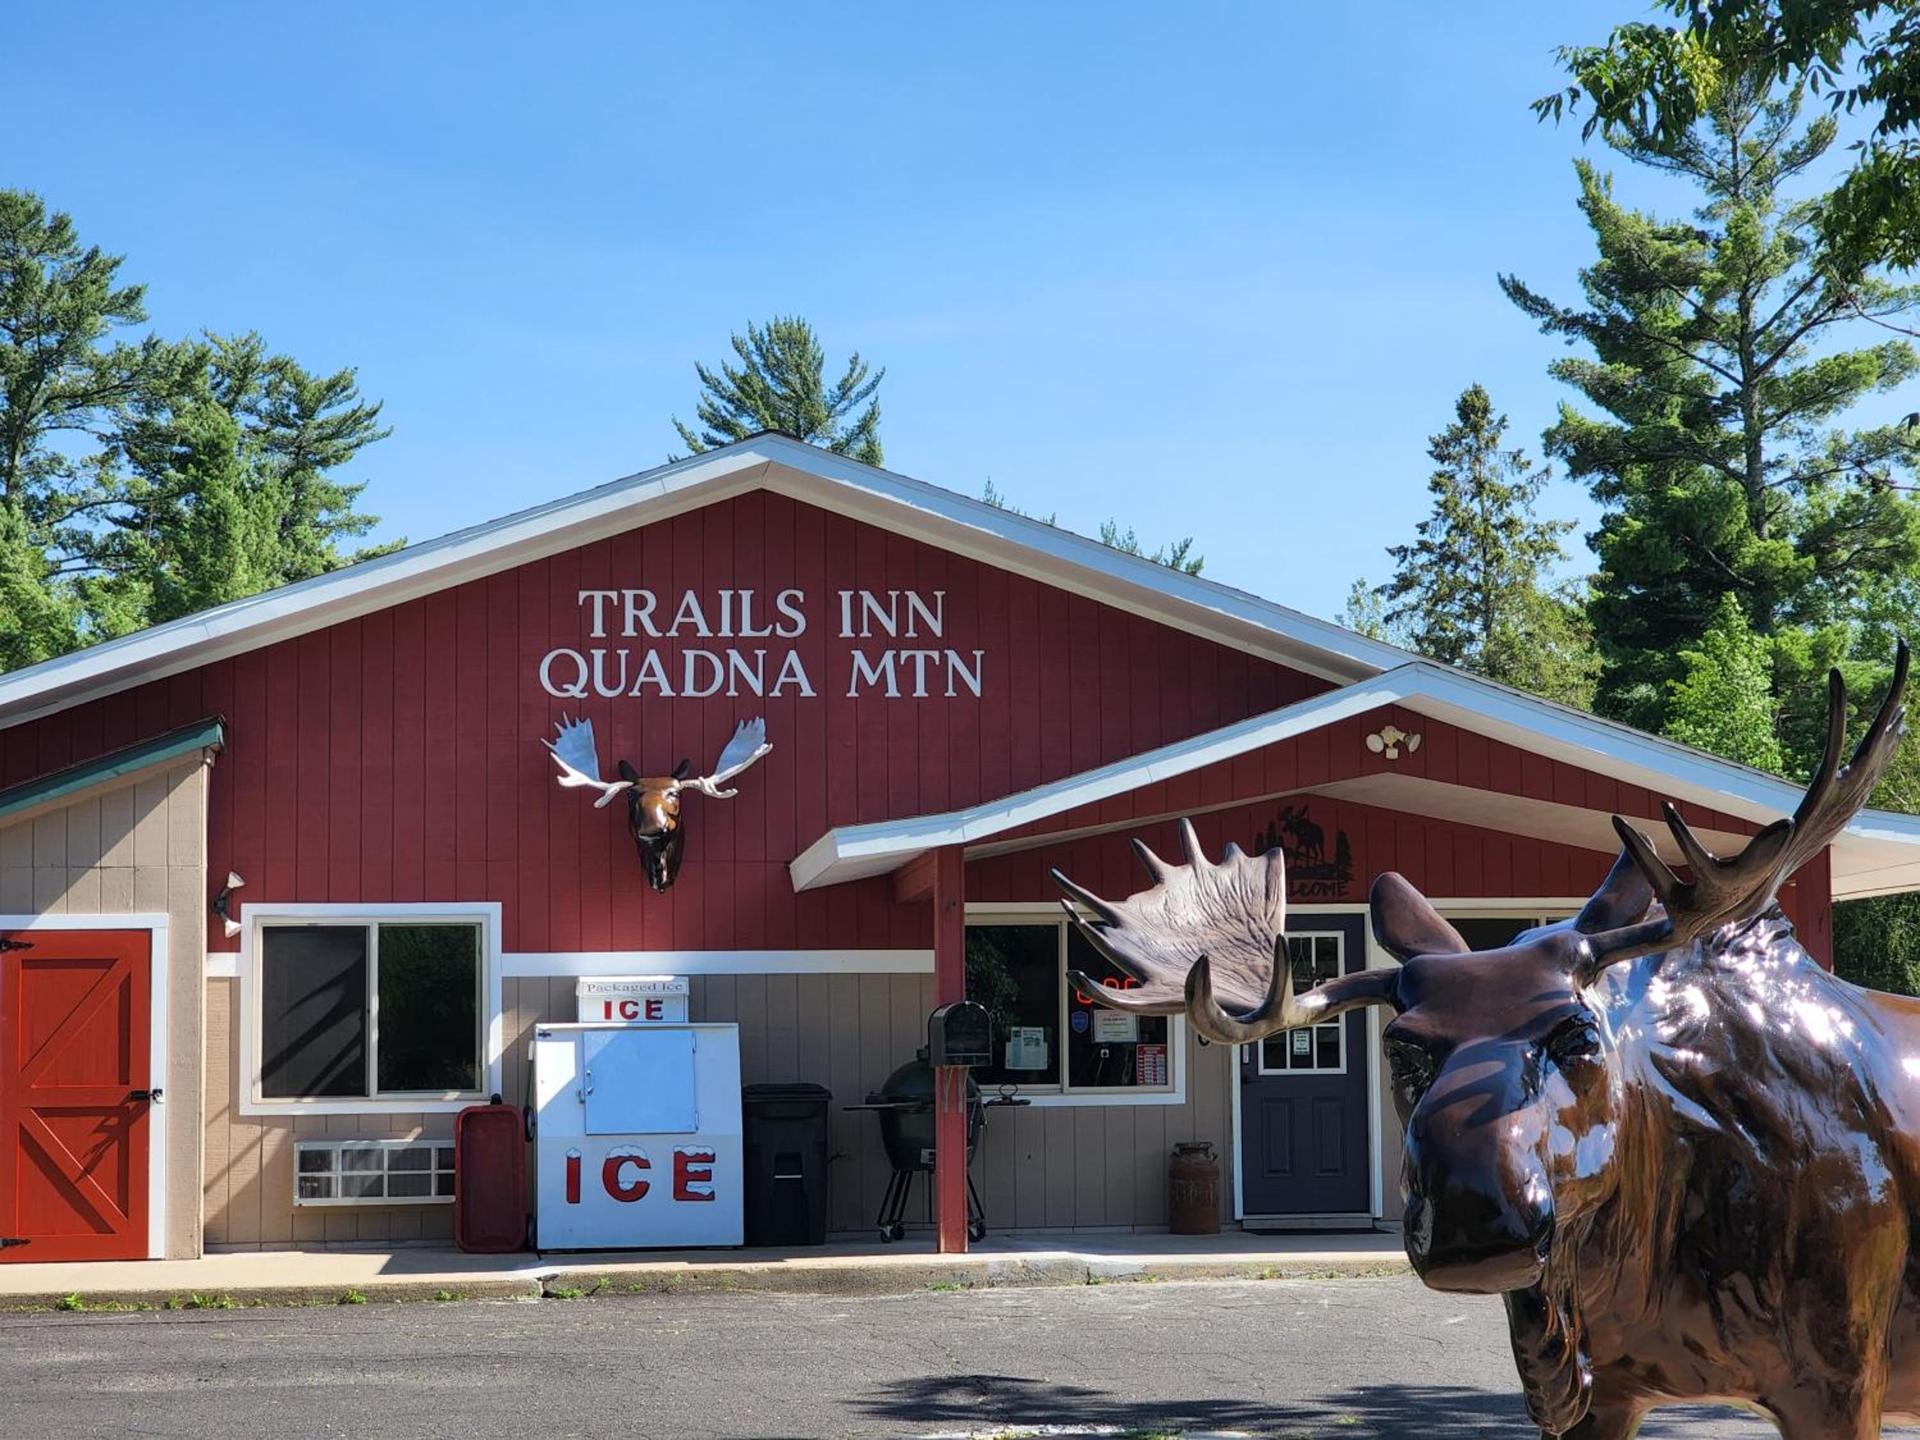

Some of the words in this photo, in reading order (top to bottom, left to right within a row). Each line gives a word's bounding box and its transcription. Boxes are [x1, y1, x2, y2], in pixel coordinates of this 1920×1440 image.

[578, 589, 806, 638] TRAILS
[838, 590, 946, 638] INN
[539, 648, 817, 699] QUADNA
[846, 649, 985, 698] MTN
[1288, 879, 1349, 898] LCOME
[587, 983, 656, 994] Packaged
[662, 983, 683, 991] Ice
[604, 999, 664, 1020] ICE
[565, 1145, 716, 1204] ICE
